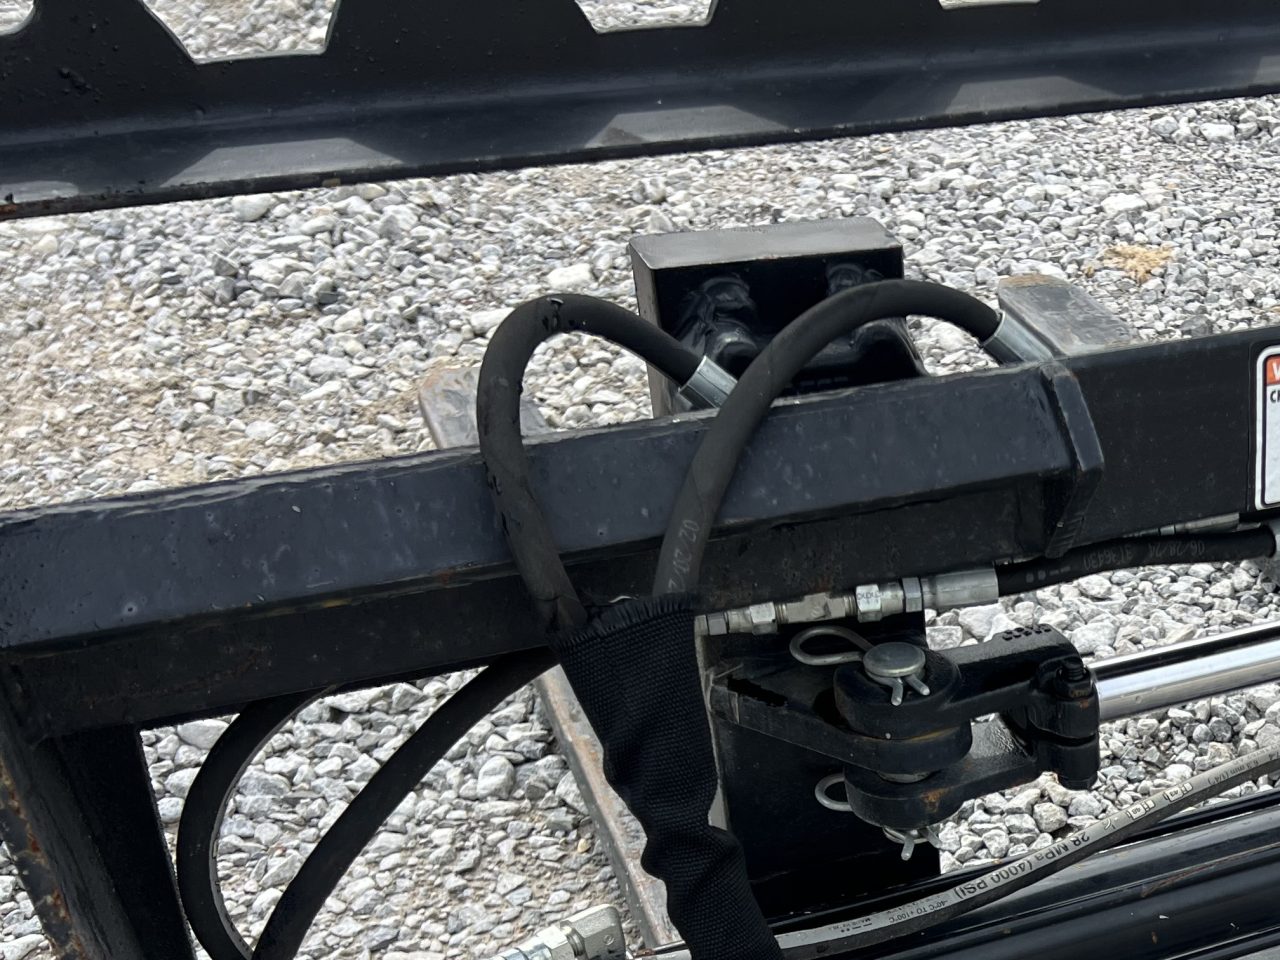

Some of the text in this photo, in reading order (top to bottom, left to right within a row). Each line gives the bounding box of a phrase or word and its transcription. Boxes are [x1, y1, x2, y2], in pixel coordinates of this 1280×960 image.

[1072, 831, 1090, 846] 28
[991, 860, 1033, 884] (4000
[954, 881, 989, 900] PSI)
